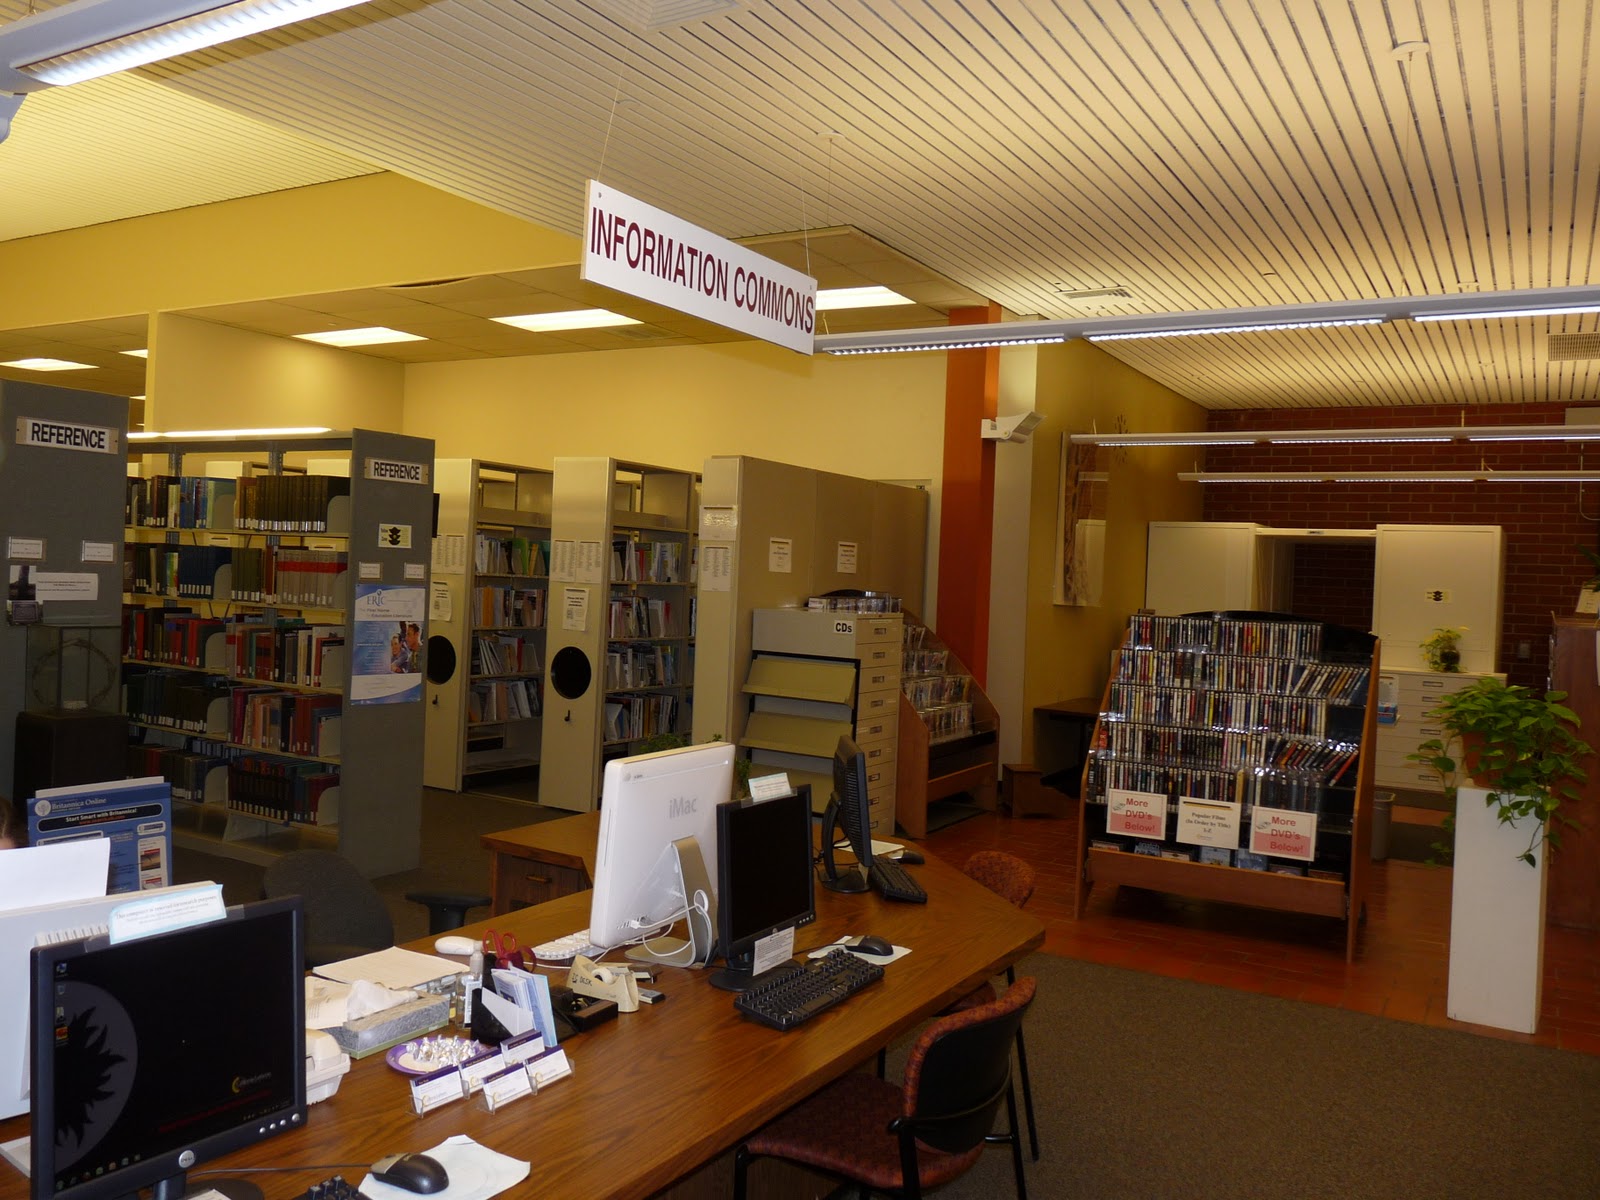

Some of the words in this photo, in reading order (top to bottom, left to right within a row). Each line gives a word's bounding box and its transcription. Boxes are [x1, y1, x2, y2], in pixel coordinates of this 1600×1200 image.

[590, 206, 729, 302] INFORMATION
[734, 266, 814, 334] COMMONS
[31, 422, 106, 449] REFERENCE
[373, 461, 420, 481] REFERENCE
[835, 622, 853, 634] CDs
[51, 800, 84, 810] Britannica
[85, 797, 107, 806] Online
[669, 796, 698, 820] iMac
[1125, 797, 1149, 808] More
[109, 808, 138, 816] Britannica!
[1125, 809, 1153, 821] DVD's
[1124, 821, 1156, 833] Below!
[1271, 815, 1297, 827] More
[1271, 828, 1301, 840] DVD's
[1270, 841, 1304, 854] Below!
[579, 976, 593, 987] DESK
